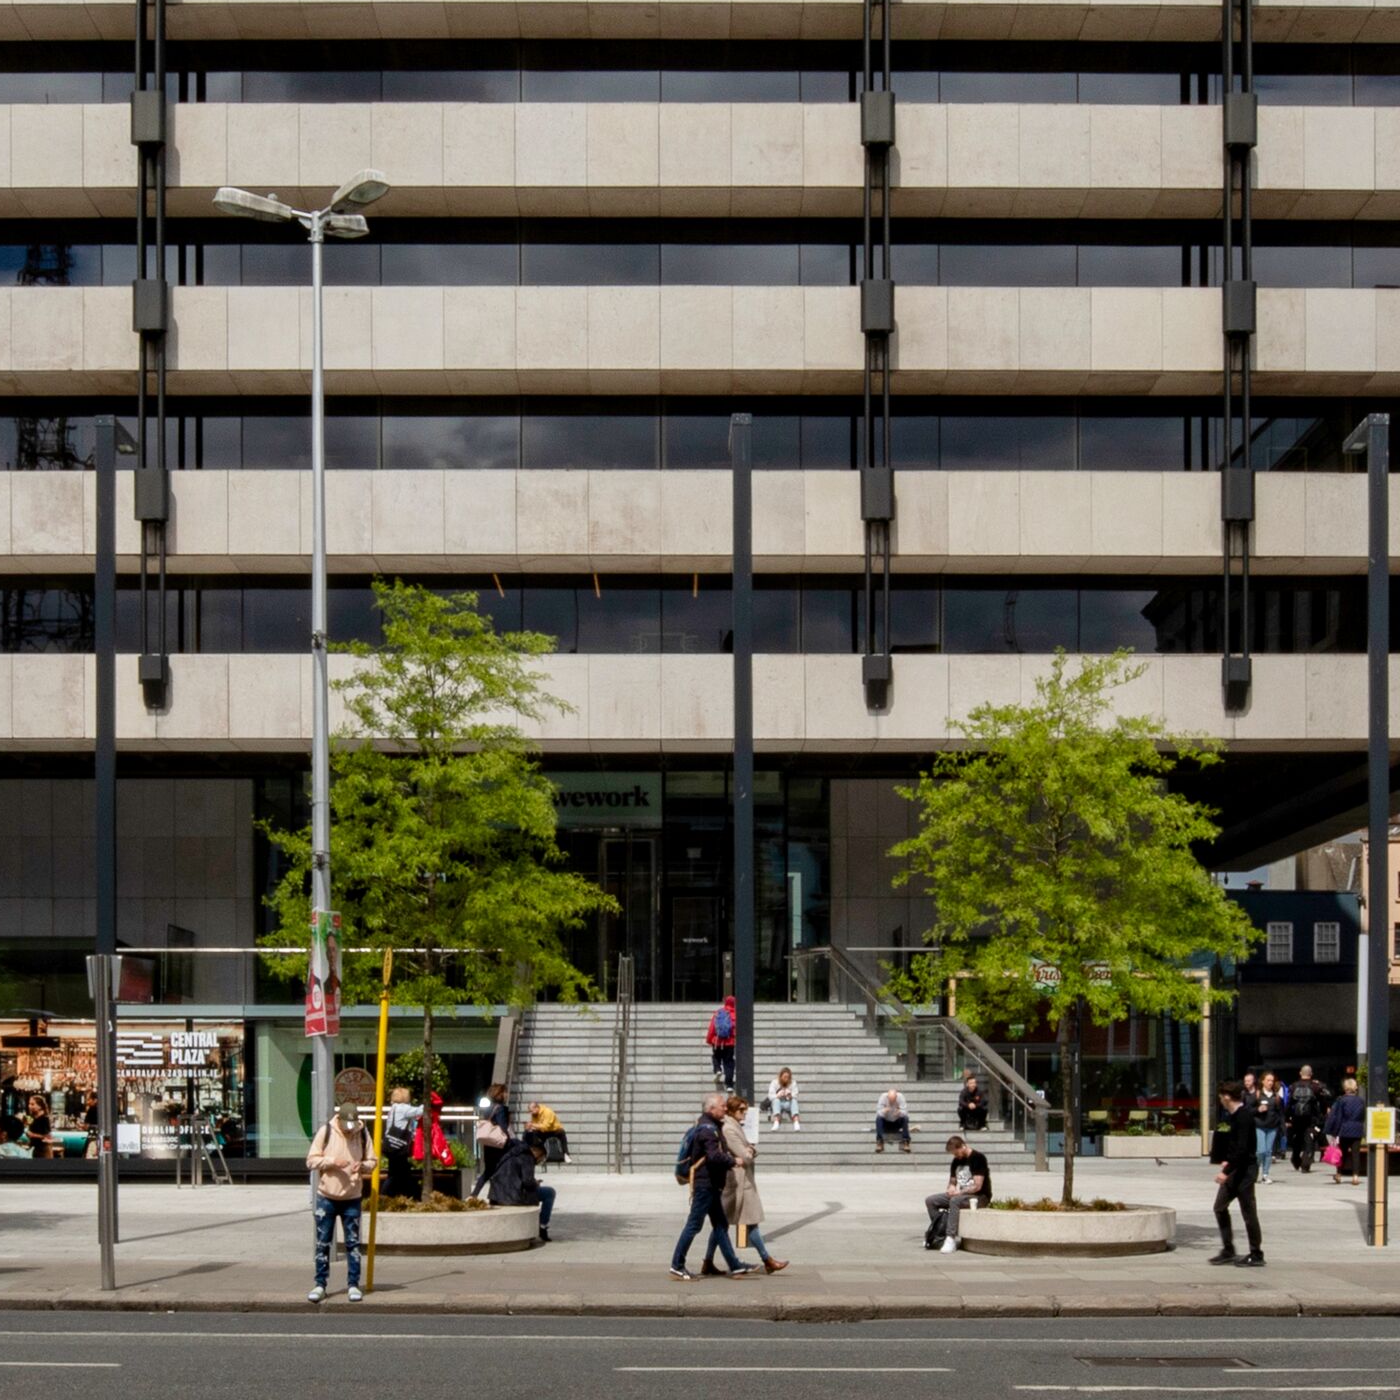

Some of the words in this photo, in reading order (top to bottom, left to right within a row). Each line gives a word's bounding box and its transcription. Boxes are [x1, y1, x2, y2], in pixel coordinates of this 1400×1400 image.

[551, 785, 650, 808] wework
[170, 1032, 219, 1048] CENTRAL
[141, 1125, 176, 1134] DUBLIN
[179, 1125, 211, 1134] OFCE
